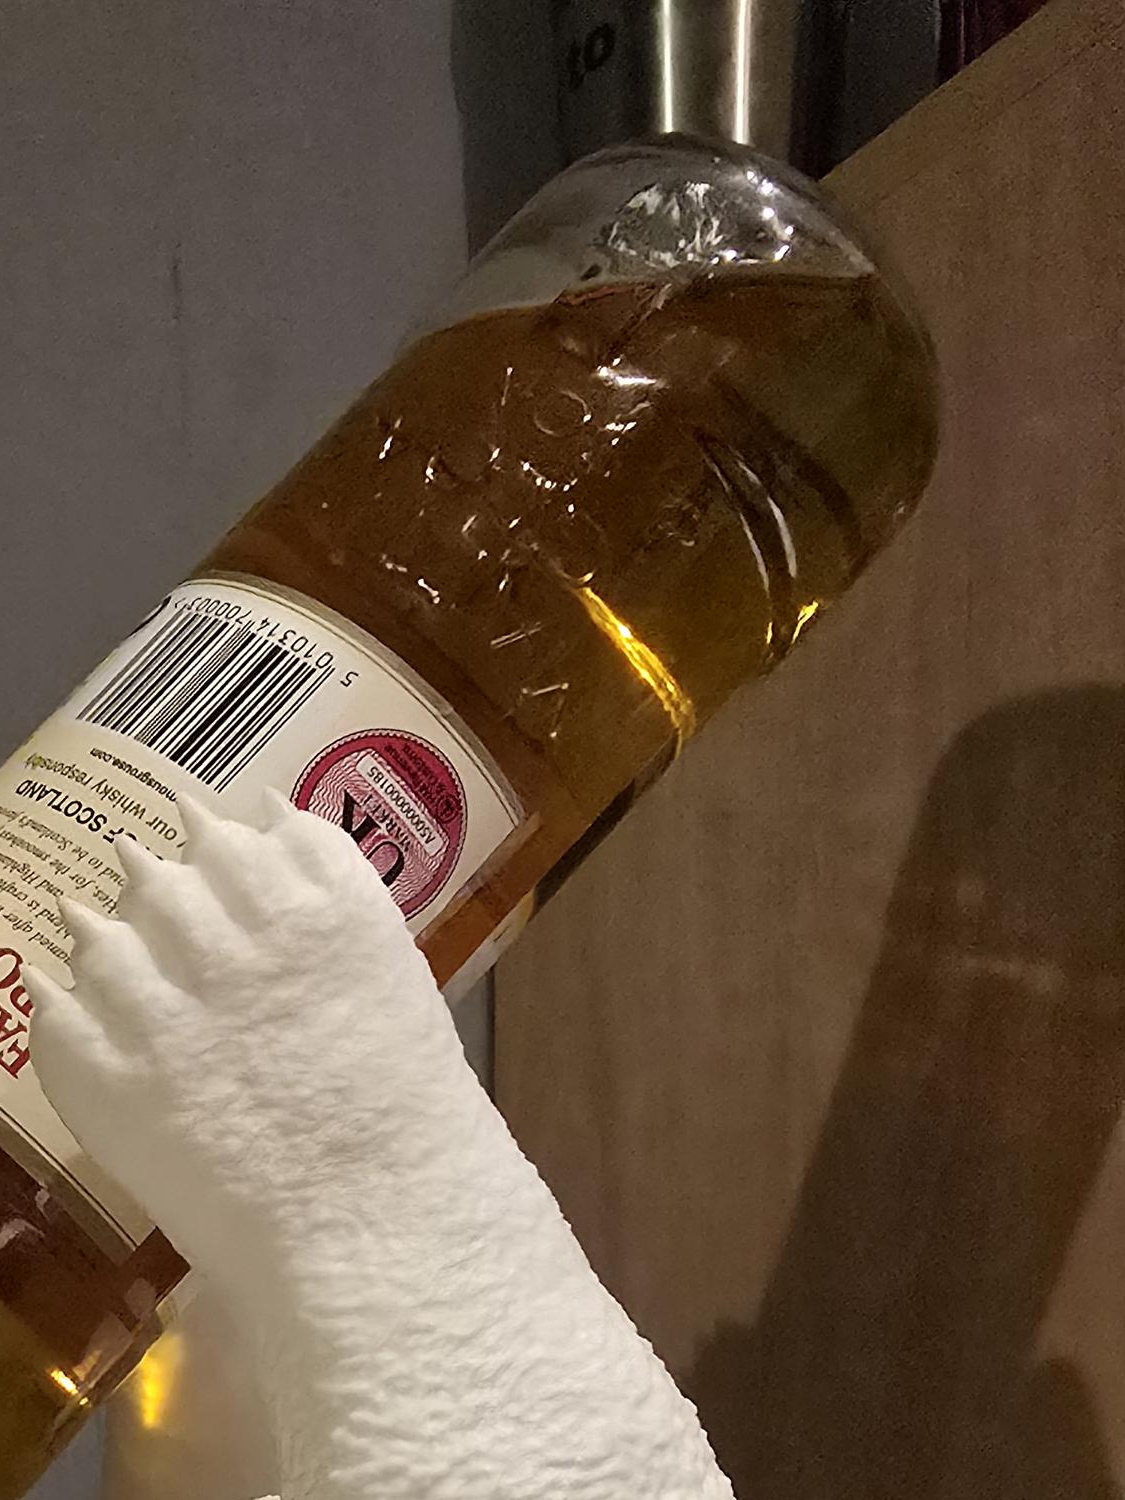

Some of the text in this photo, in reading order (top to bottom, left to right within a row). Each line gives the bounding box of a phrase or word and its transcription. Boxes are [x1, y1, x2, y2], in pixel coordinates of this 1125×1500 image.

[257, 619, 334, 670] 010314
[338, 669, 358, 688] 5
[88, 746, 177, 803] mousgrouse.com
[16, 778, 109, 833] SCOTLAND
[89, 778, 148, 819] whisky
[144, 815, 179, 842] our
[71, 845, 89, 861] be
[86, 855, 103, 870] to
[49, 857, 70, 875] the
[34, 878, 63, 898] and
[68, 872, 96, 890] for
[26, 898, 39, 911] is
[2, 910, 33, 933] after
